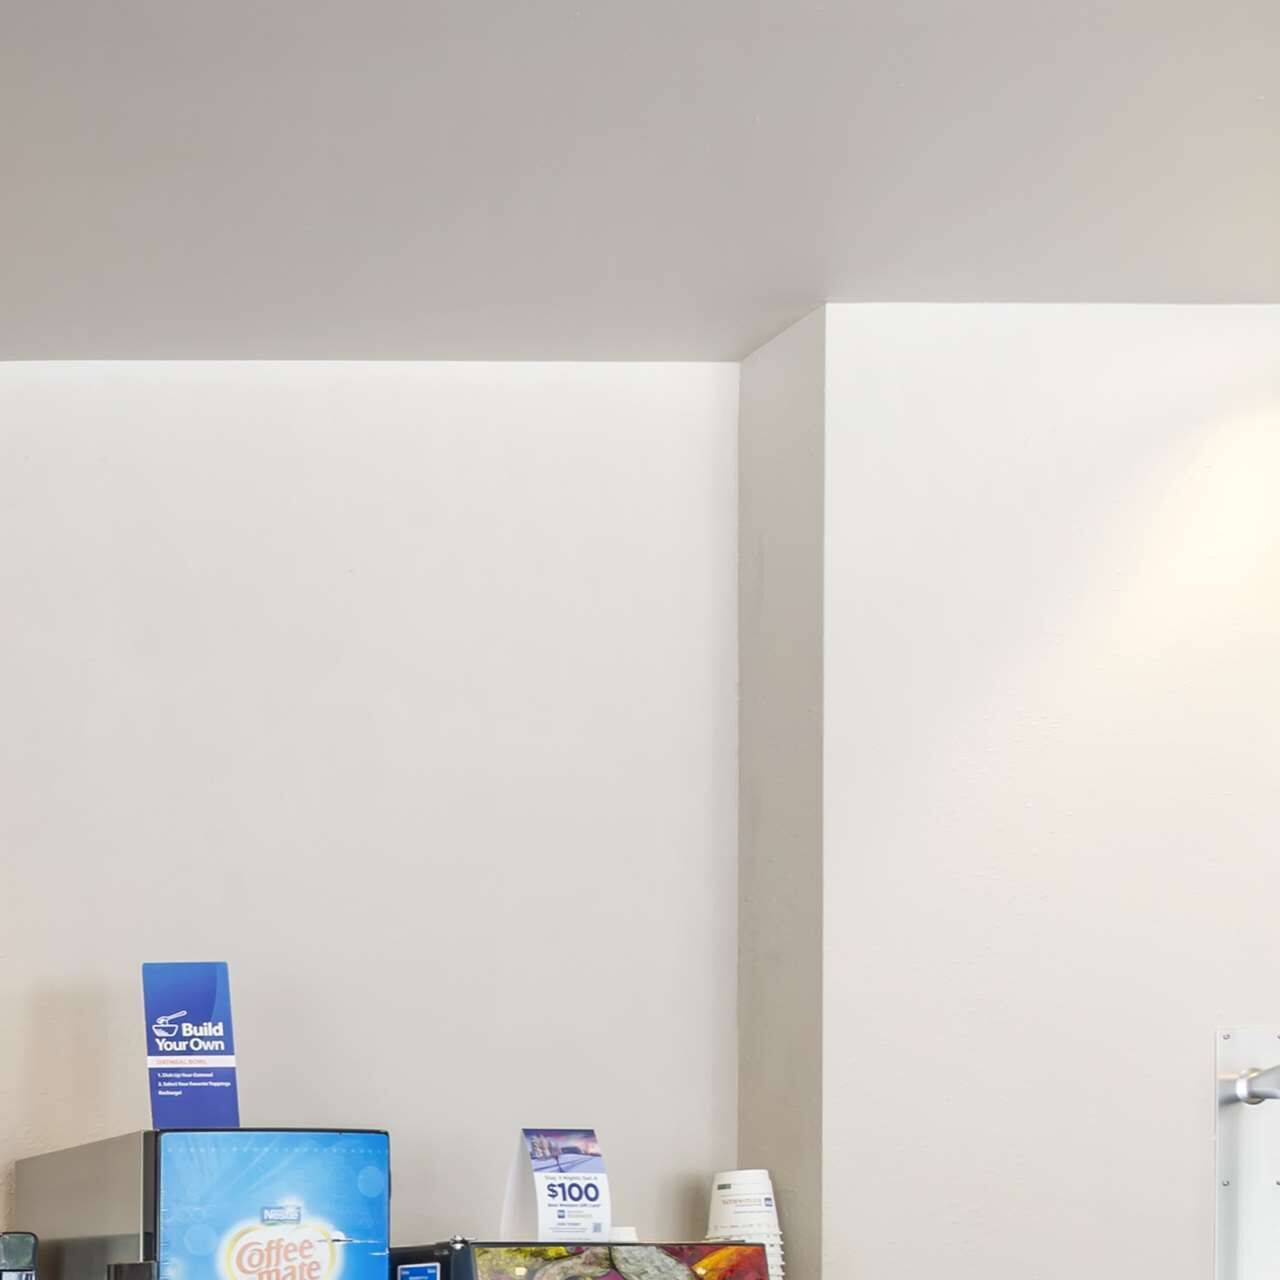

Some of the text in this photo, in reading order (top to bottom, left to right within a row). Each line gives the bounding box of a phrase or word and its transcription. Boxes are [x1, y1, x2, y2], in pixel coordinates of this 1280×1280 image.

[181, 1022, 224, 1037] Build
[155, 1037, 225, 1051] Your Own
[546, 1182, 600, 1202] $100
[235, 1237, 315, 1275] Coffee
